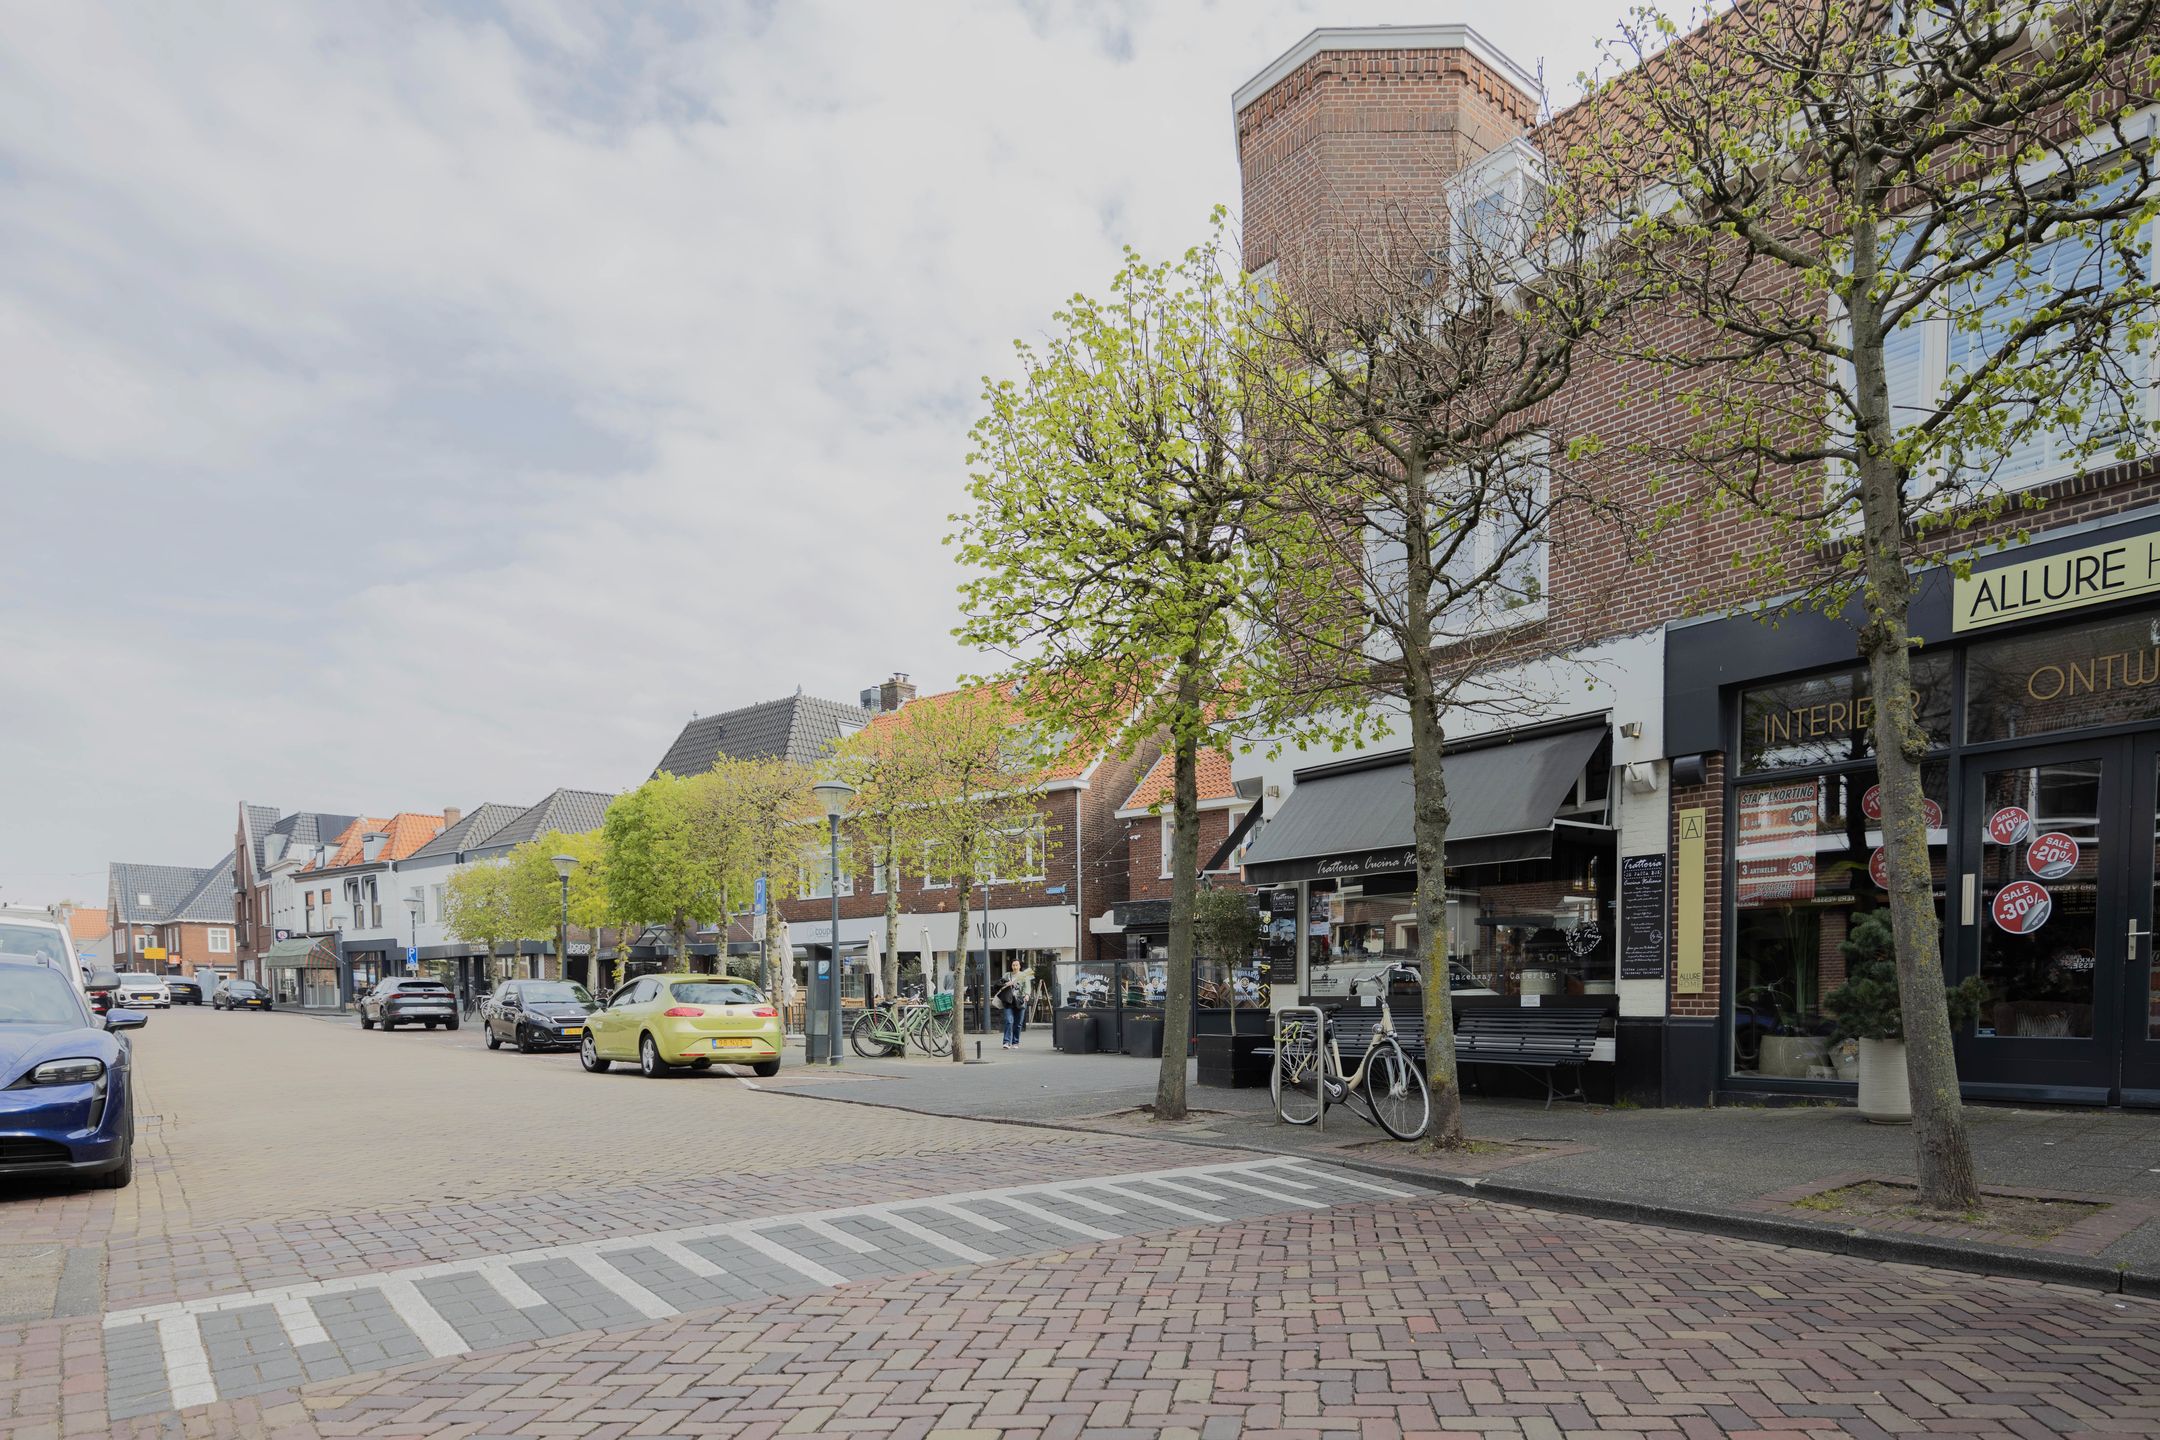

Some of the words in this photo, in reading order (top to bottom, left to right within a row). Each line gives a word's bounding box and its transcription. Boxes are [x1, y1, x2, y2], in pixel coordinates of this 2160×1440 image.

[1970, 547, 2126, 617] ALLURE
[1764, 690, 1921, 743] INTERIER
[1789, 808, 1814, 822] -10%
[1996, 810, 2016, 823] SALE
[1994, 815, 2027, 835] -10%
[2046, 837, 2071, 849] SALE
[2032, 845, 2073, 863] -20%
[1317, 860, 1359, 874] Trattoria
[1364, 856, 1400, 869] Cucina
[1624, 858, 1662, 870] Trattoria
[1742, 865, 1748, 875] 3
[1788, 860, 1813, 873] -30%
[2002, 885, 2031, 901] SALE
[1999, 892, 2045, 920] -30%
[1680, 972, 1701, 980] ALLURE
